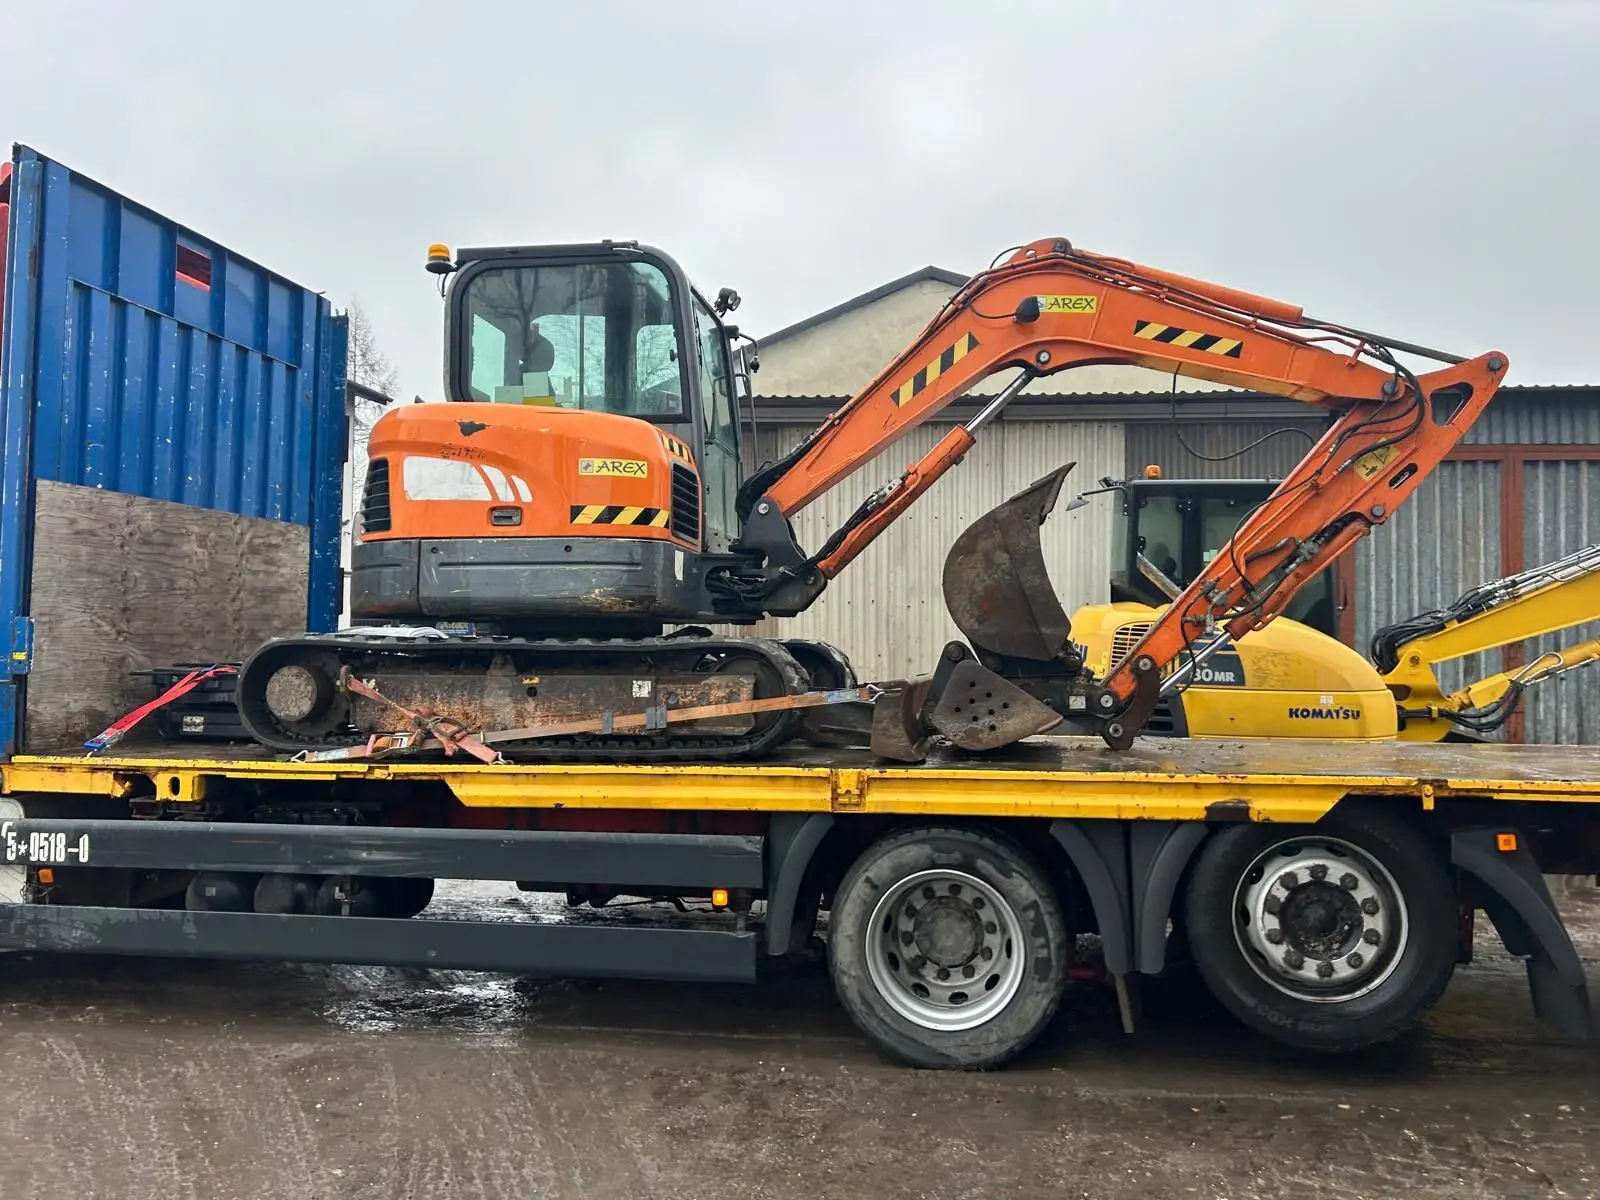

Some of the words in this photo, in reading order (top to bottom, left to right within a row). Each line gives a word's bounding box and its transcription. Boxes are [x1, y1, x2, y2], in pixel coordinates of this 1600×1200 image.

[1048, 297, 1094, 310] AREX
[596, 461, 645, 475] AREX
[1288, 706, 1360, 720] KOMATSU
